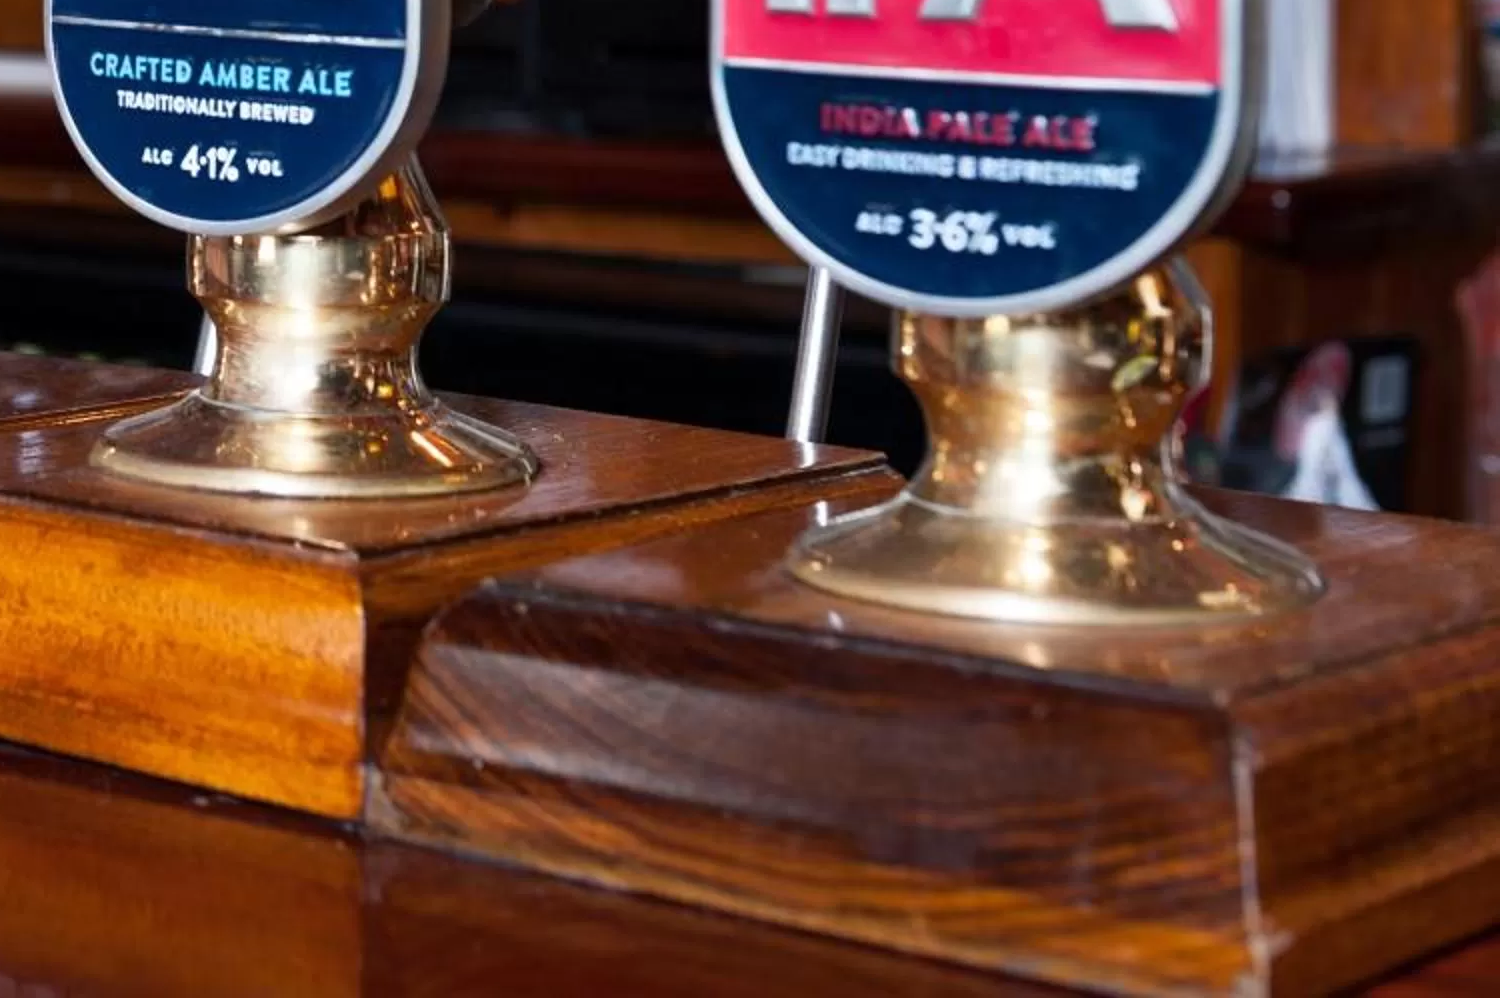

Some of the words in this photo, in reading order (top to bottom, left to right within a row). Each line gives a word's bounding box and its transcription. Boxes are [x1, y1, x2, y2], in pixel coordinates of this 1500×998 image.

[90, 52, 193, 86] CRAFTED
[199, 60, 293, 93] AMBER
[297, 68, 353, 97] ALE
[117, 89, 238, 119] TRADITIONALLY
[239, 101, 316, 126] BREWED
[819, 101, 922, 139] INDIA
[926, 108, 1021, 147] PALE
[1023, 111, 1099, 151] ALE
[141, 147, 173, 166] ALC
[246, 156, 284, 178] VOL
[786, 141, 841, 167] EASY
[841, 145, 955, 179] DRINKING
[979, 156, 1143, 192] REFRESHING
[1001, 221, 1057, 250] VOL
